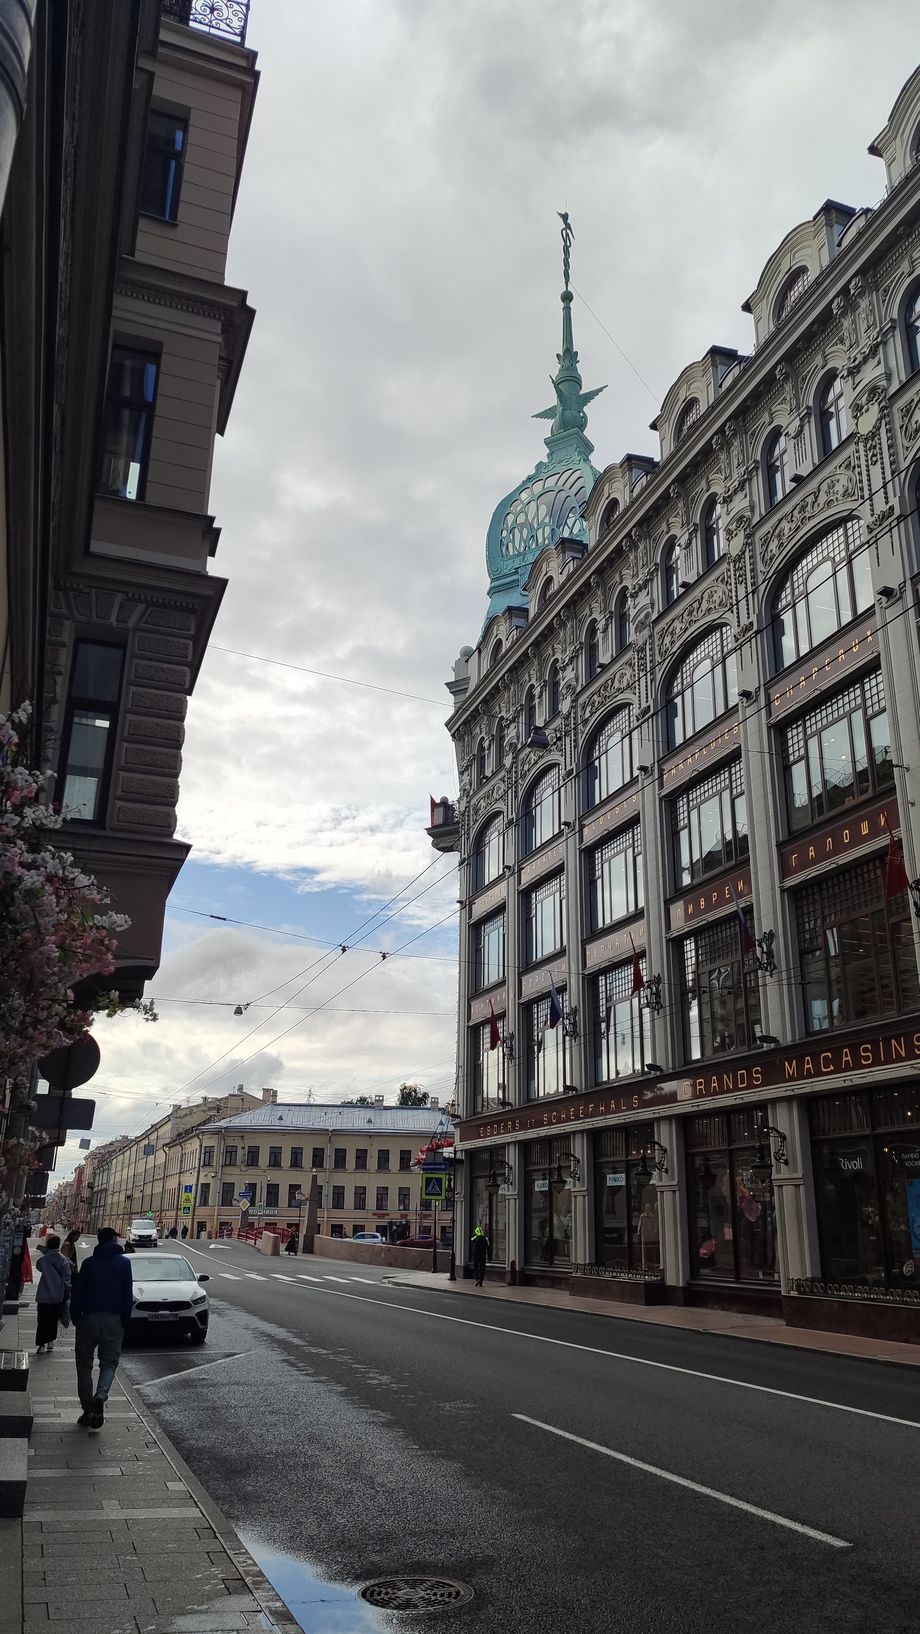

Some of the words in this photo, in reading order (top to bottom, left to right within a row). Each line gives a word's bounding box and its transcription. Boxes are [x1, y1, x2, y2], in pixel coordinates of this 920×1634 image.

[773, 629, 873, 706] CHAPEAUX
[791, 811, 888, 868] ГАЛОШИ
[480, 1119, 520, 1137] ESDERS
[543, 1095, 640, 1125] SCHEEFHALS
[682, 1066, 763, 1098] GRANDS
[839, 1157, 863, 1170] Rivoli
